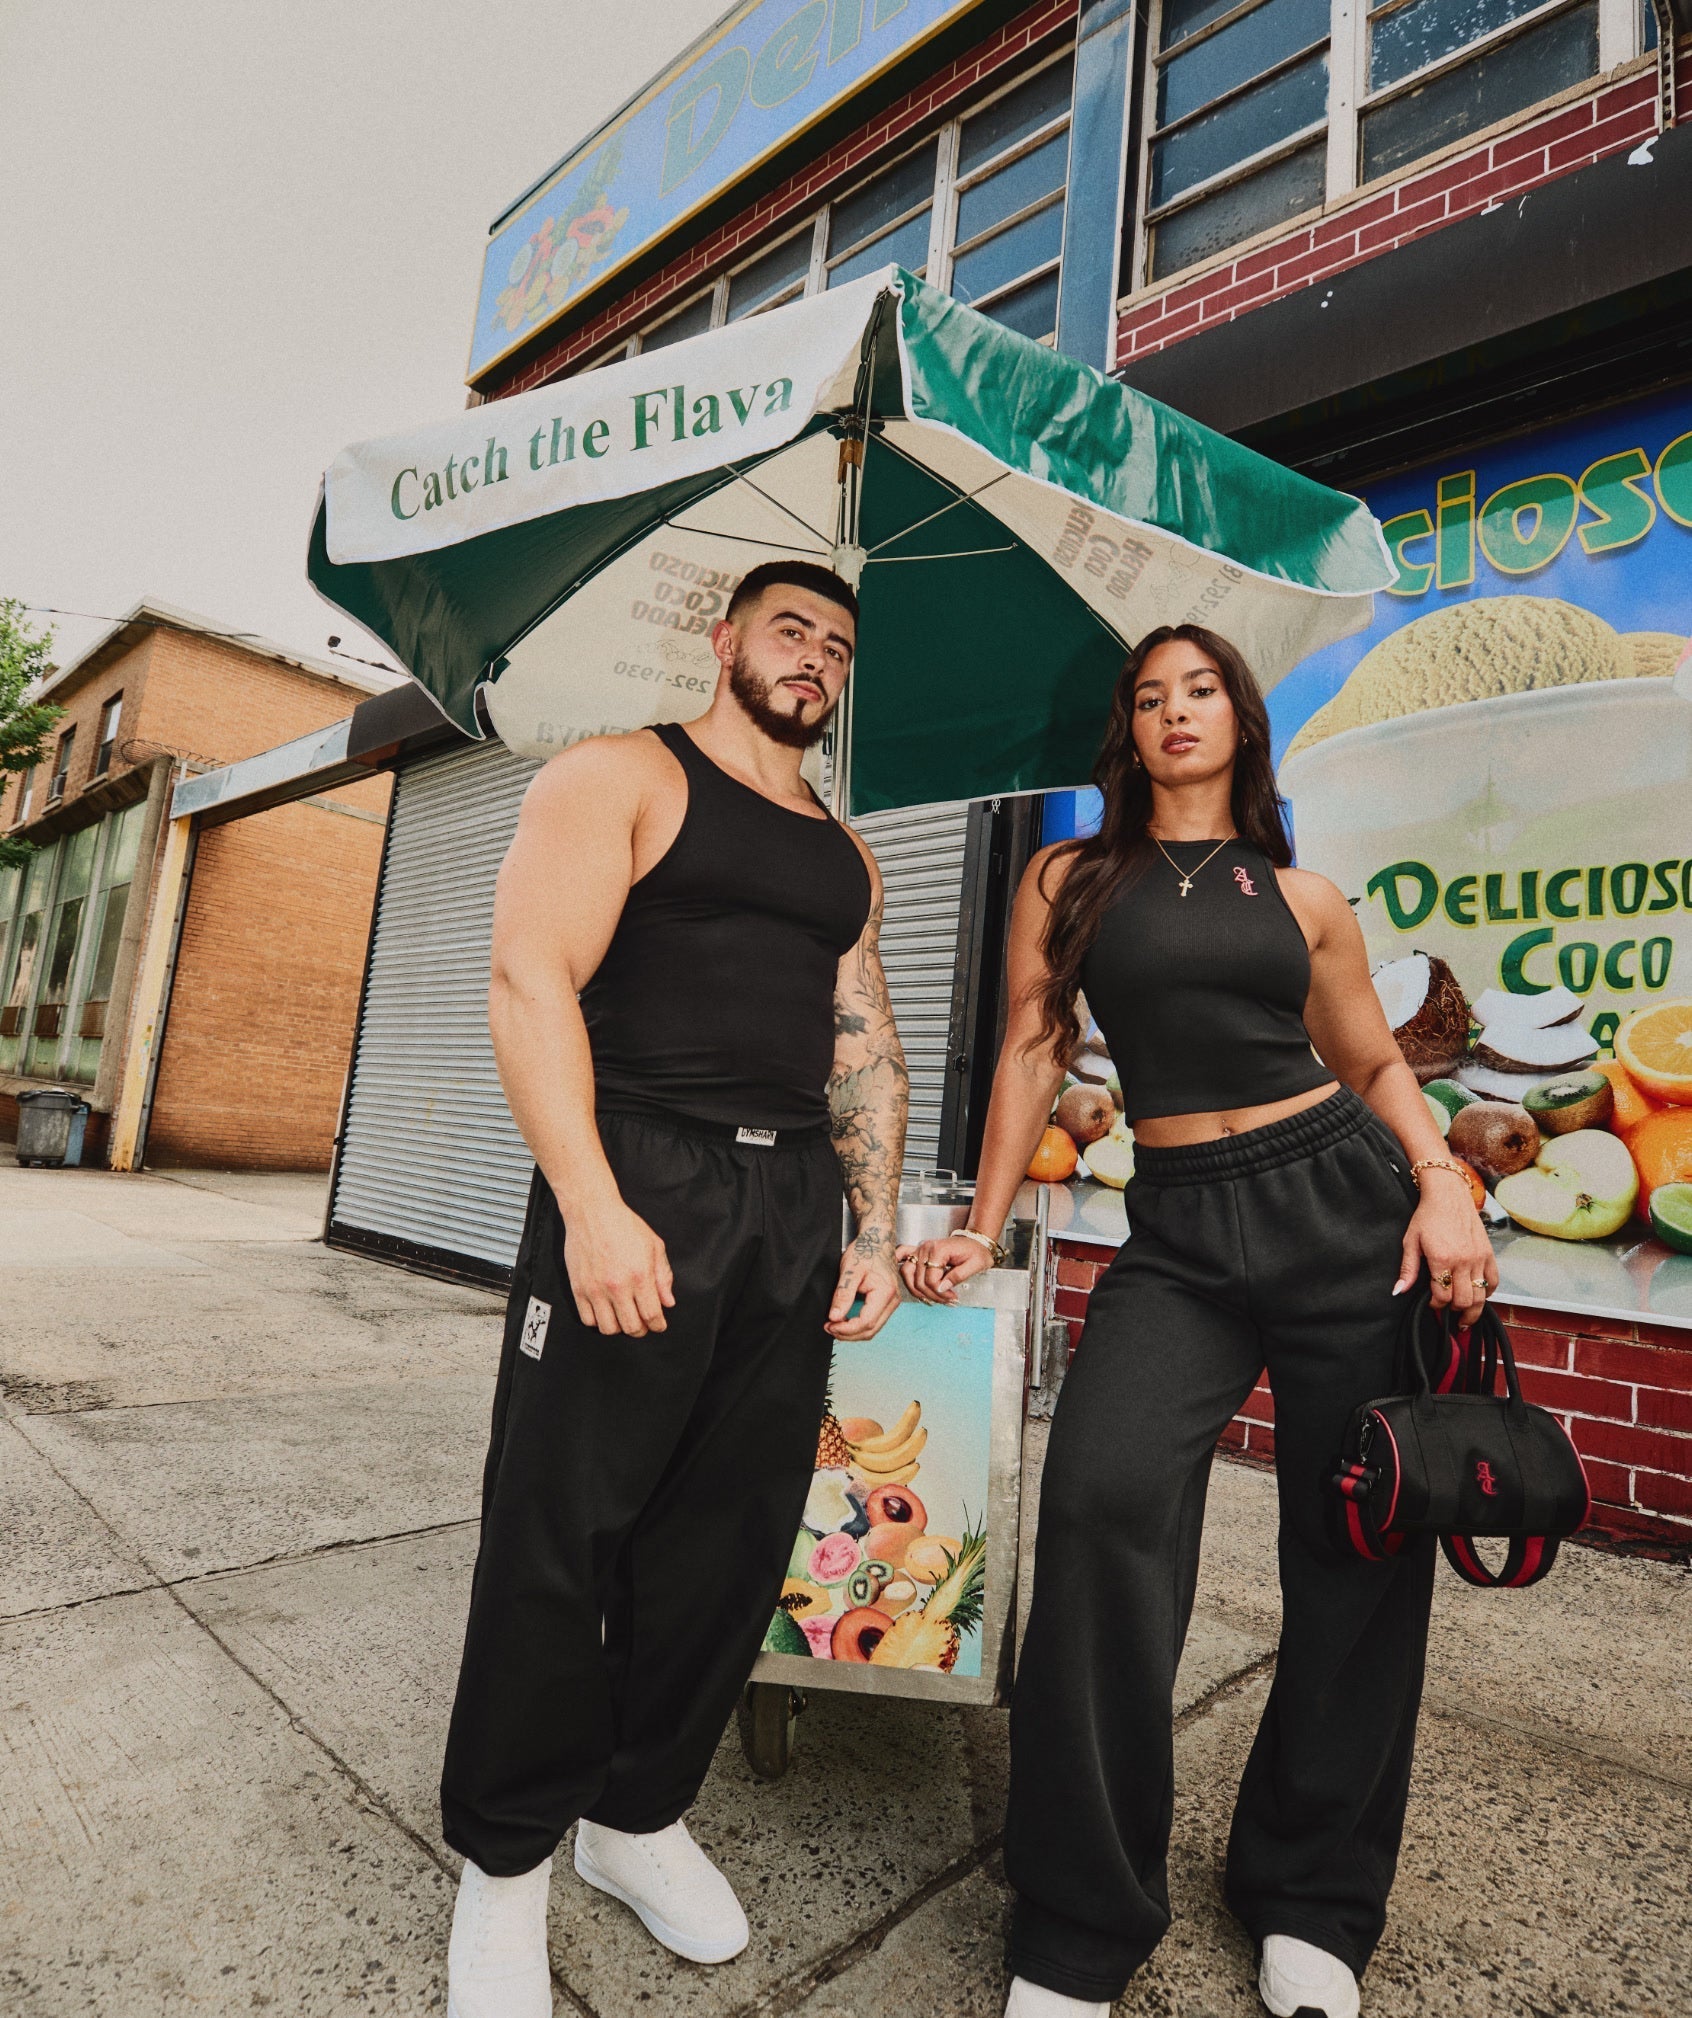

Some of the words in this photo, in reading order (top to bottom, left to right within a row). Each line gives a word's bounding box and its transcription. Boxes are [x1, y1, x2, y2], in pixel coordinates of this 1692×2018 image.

[659, 0, 909, 198] De
[390, 435, 508, 521] Catch
[529, 416, 610, 472] the
[629, 376, 794, 451] Flava
[1380, 430, 1692, 597] cios
[1366, 858, 1692, 933] DELICIOS
